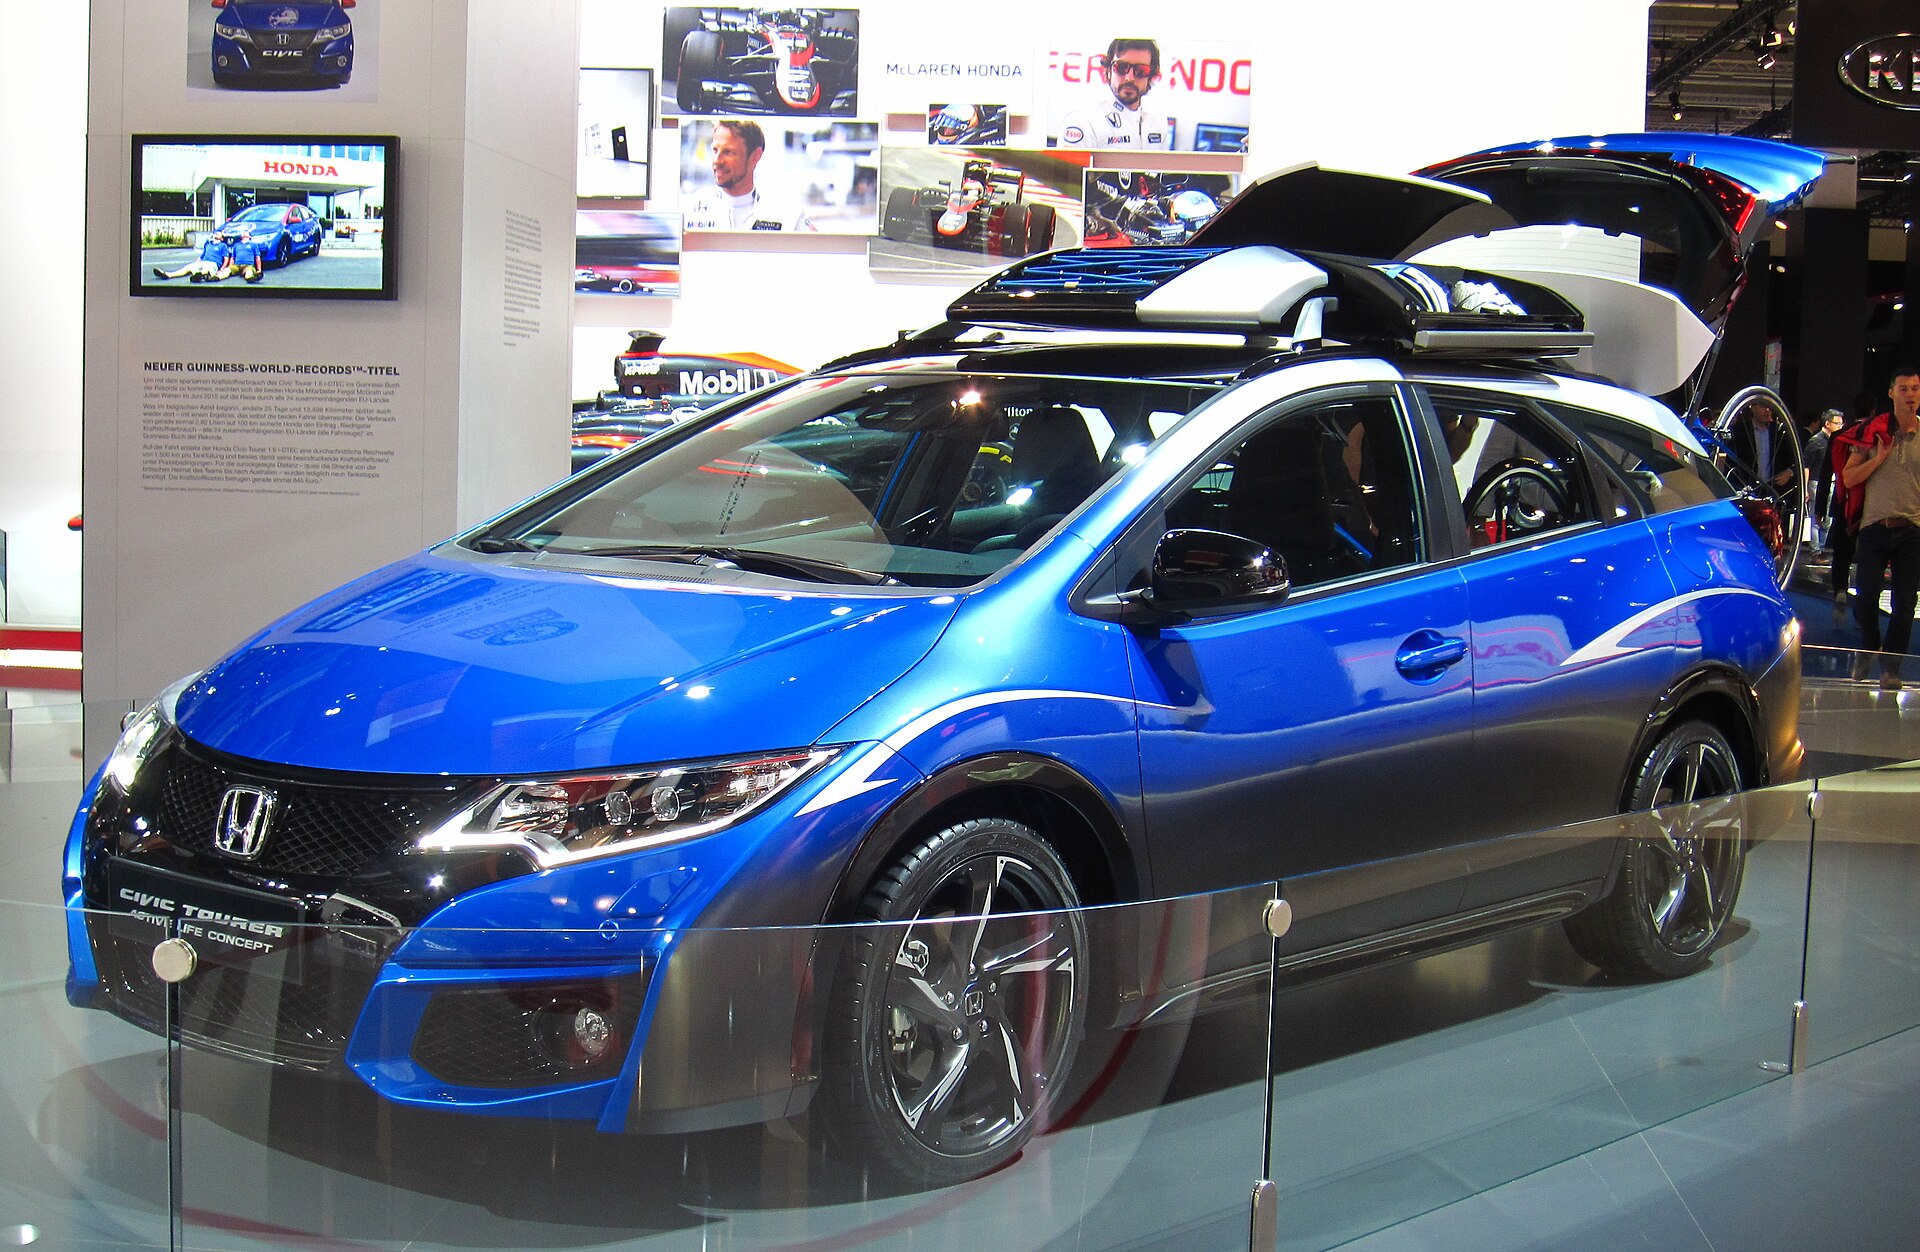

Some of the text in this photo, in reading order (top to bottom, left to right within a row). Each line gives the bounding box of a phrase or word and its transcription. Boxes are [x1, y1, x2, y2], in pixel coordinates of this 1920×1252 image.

[262, 50, 303, 58] CIVIC
[886, 63, 1022, 77] McLAREN HONDA
[263, 161, 339, 177] HONDA
[144, 362, 183, 372] NEUER
[680, 368, 750, 396] Mobil
[119, 887, 283, 938] CIVIC TOURER
[207, 930, 274, 954] CONCEPT
